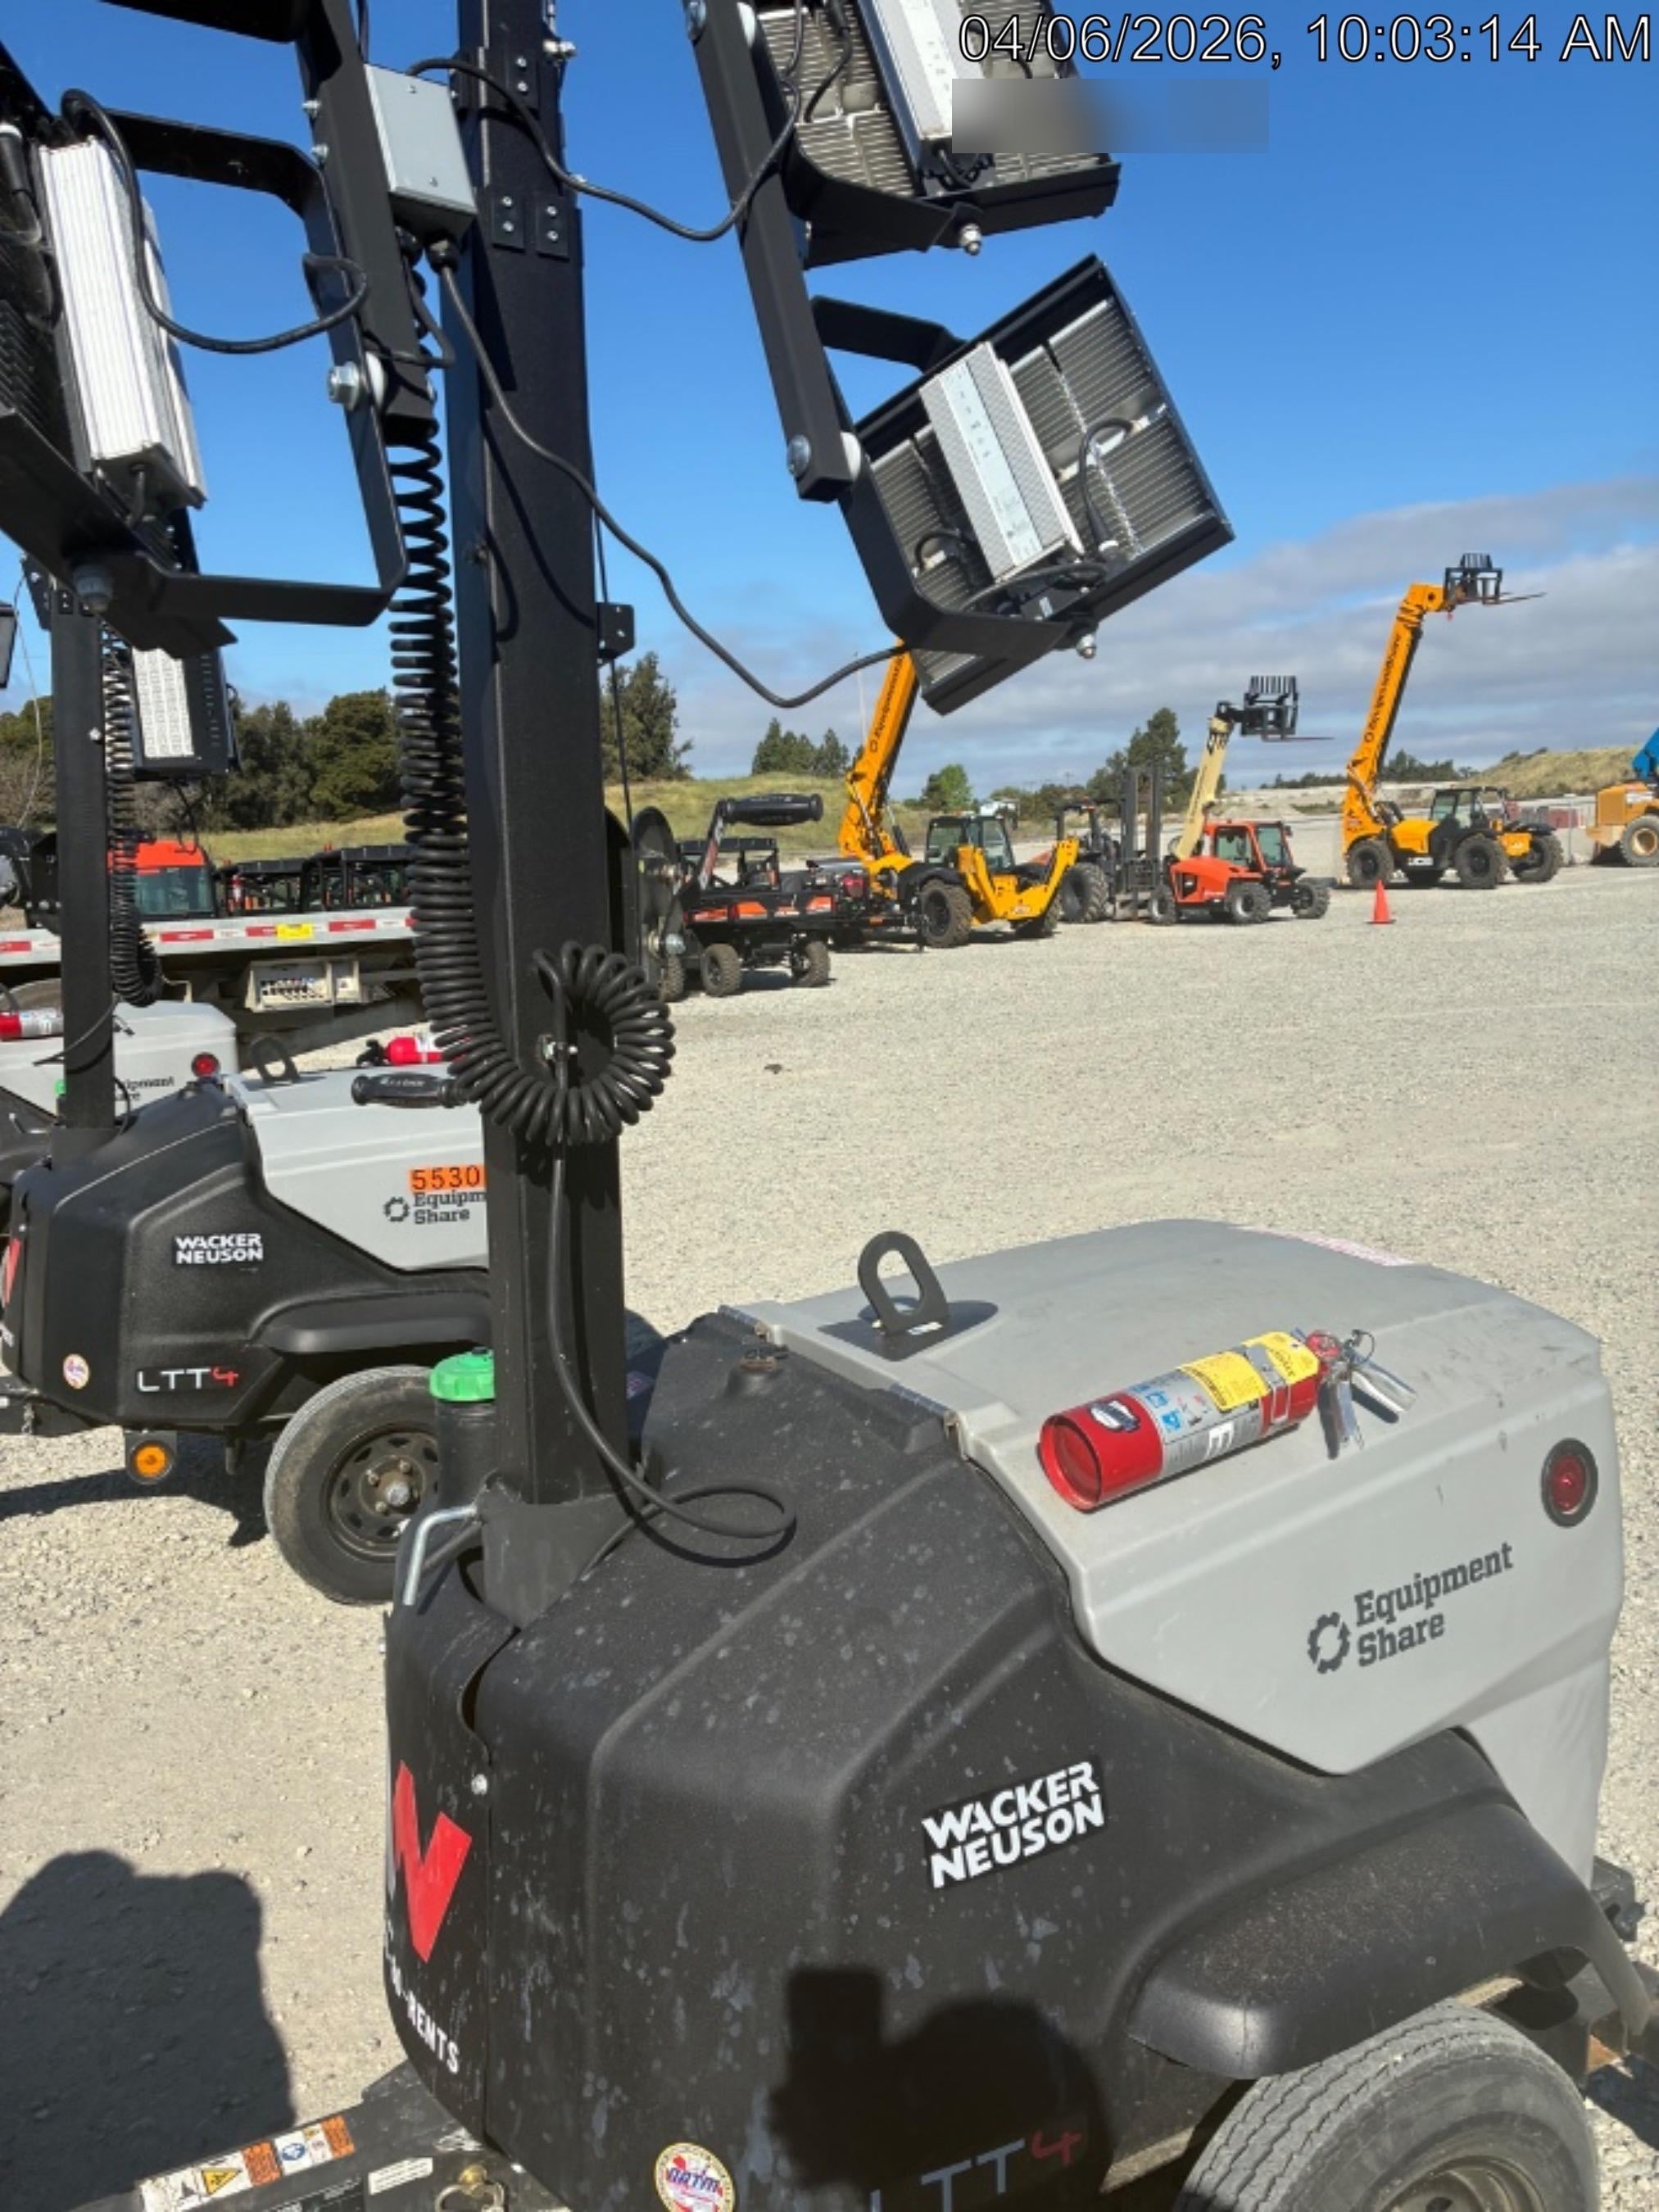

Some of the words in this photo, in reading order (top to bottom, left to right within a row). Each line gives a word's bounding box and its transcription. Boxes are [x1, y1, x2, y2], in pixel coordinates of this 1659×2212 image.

[414, 1190, 485, 1209] Equipm
[414, 1209, 470, 1225] Share
[175, 1233, 261, 1249] WACKER
[175, 1246, 264, 1263] NEUSON
[1354, 1541, 1513, 1627] Equipment
[1357, 1612, 1444, 1666] Share
[922, 1761, 1099, 1849] WACKER
[930, 1793, 1104, 1889] NEUSON
